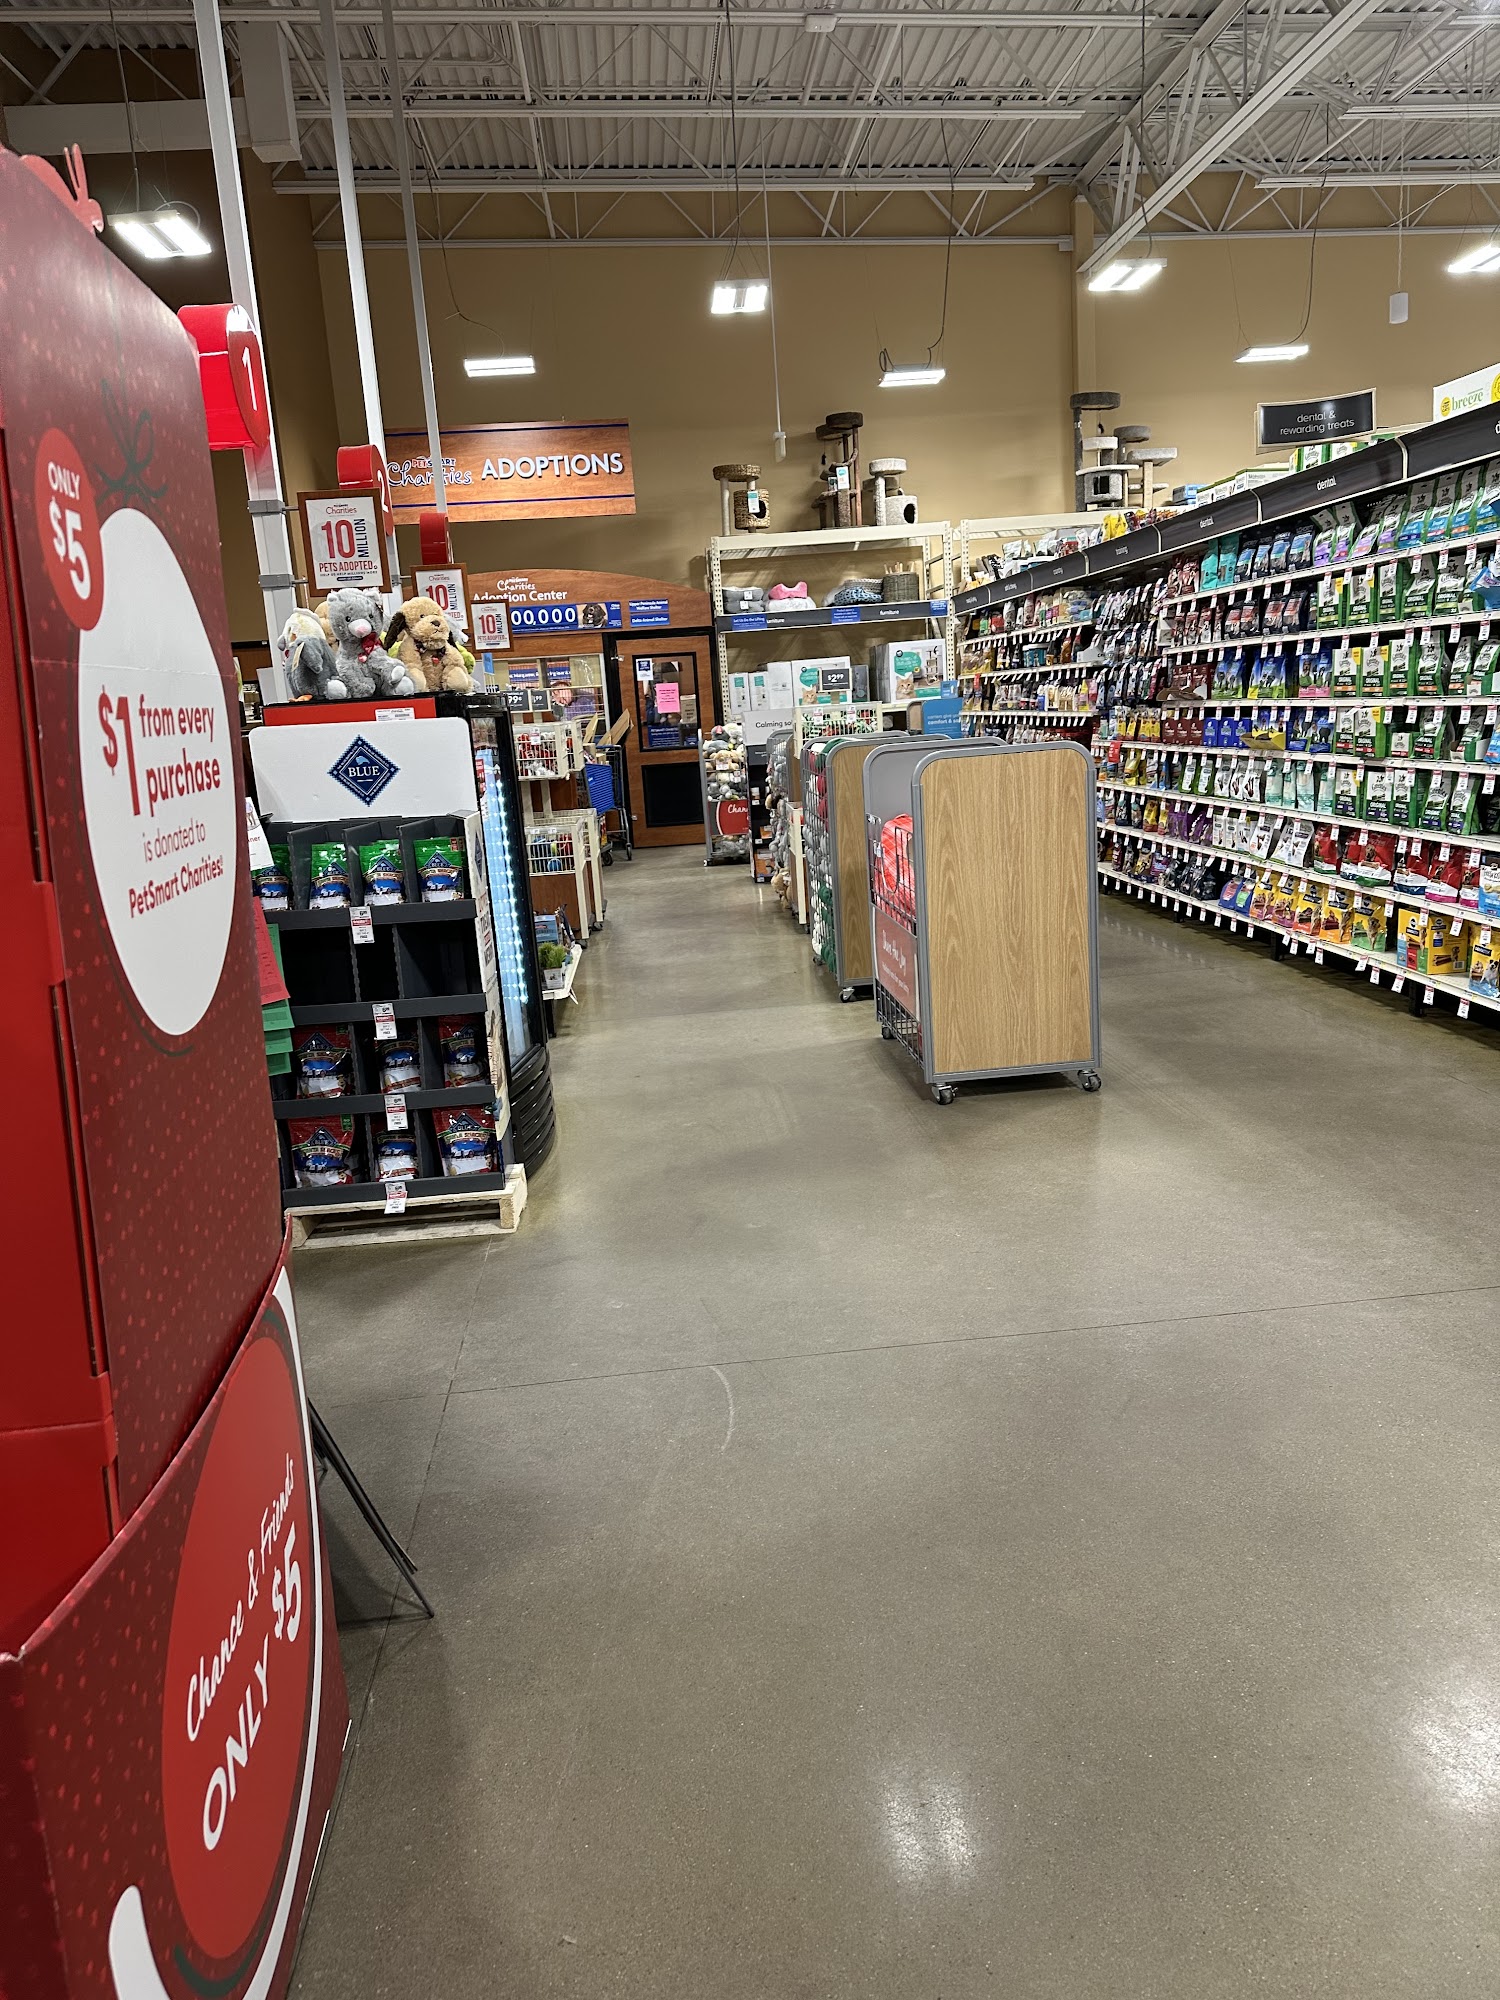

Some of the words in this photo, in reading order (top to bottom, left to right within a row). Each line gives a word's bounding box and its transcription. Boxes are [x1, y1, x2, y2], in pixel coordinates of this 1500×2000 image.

[242, 346, 258, 411] 1
[1451, 391, 1484, 411] breeze
[1280, 423, 1325, 435] rewarding
[1327, 419, 1355, 431] treats
[1297, 411, 1327, 423] dental
[1328, 410, 1336, 420] &
[387, 460, 473, 487] Charties
[481, 453, 624, 480] ADOPTIONS
[411, 456, 457, 469] PETSART
[48, 461, 81, 501] ONLY
[1316, 475, 1337, 491] dental
[325, 506, 358, 515] Charities
[49, 495, 92, 601] $5
[321, 519, 356, 559] 10
[353, 518, 370, 558] MILLION
[318, 562, 338, 573] PETS
[338, 560, 374, 572] ADOPTED
[496, 579, 537, 592] Charities
[528, 589, 568, 601] Center
[425, 584, 449, 611] 10
[447, 583, 458, 611] MILLION
[478, 614, 497, 635] 10
[755, 720, 783, 729] Calming
[98, 684, 141, 816] $1
[138, 694, 176, 738] from
[177, 706, 215, 743] every
[347, 765, 381, 778] BLUE
[146, 747, 221, 818] purchase
[727, 803, 748, 814] Chan
[143, 832, 153, 863] is
[154, 817, 195, 859] donated
[195, 821, 206, 845] to
[128, 871, 180, 919] PetSmart
[186, 1599, 245, 1742] Chance
[247, 1548, 259, 1610] &
[260, 1452, 295, 1574] Friends
[202, 1632, 270, 1851] ONLY
[271, 1521, 302, 1642] $5
